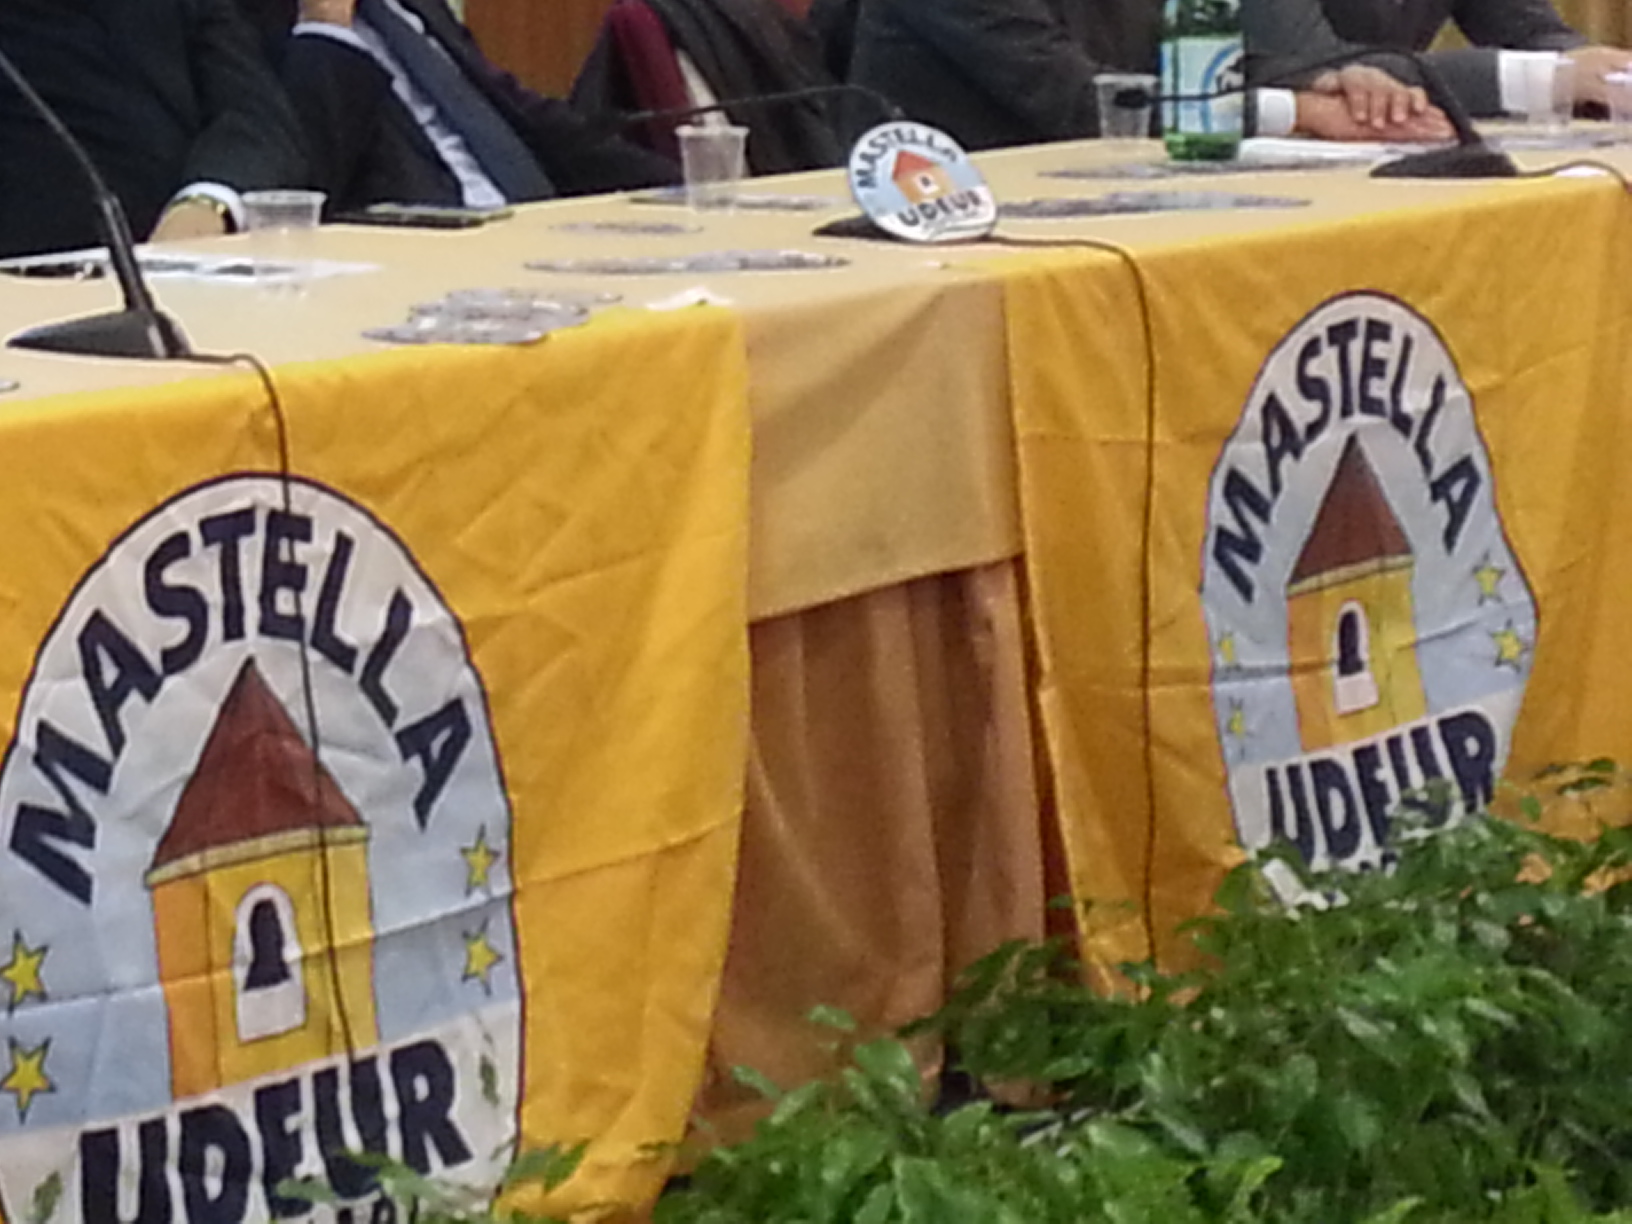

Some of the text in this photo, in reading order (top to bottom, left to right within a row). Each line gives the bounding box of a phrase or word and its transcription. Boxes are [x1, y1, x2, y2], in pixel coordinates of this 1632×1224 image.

[1213, 318, 1481, 604] MASTELLA
[9, 507, 472, 906] MASTELLA
[1265, 711, 1496, 866] UDEUR
[80, 1039, 473, 1224] UDEUR
